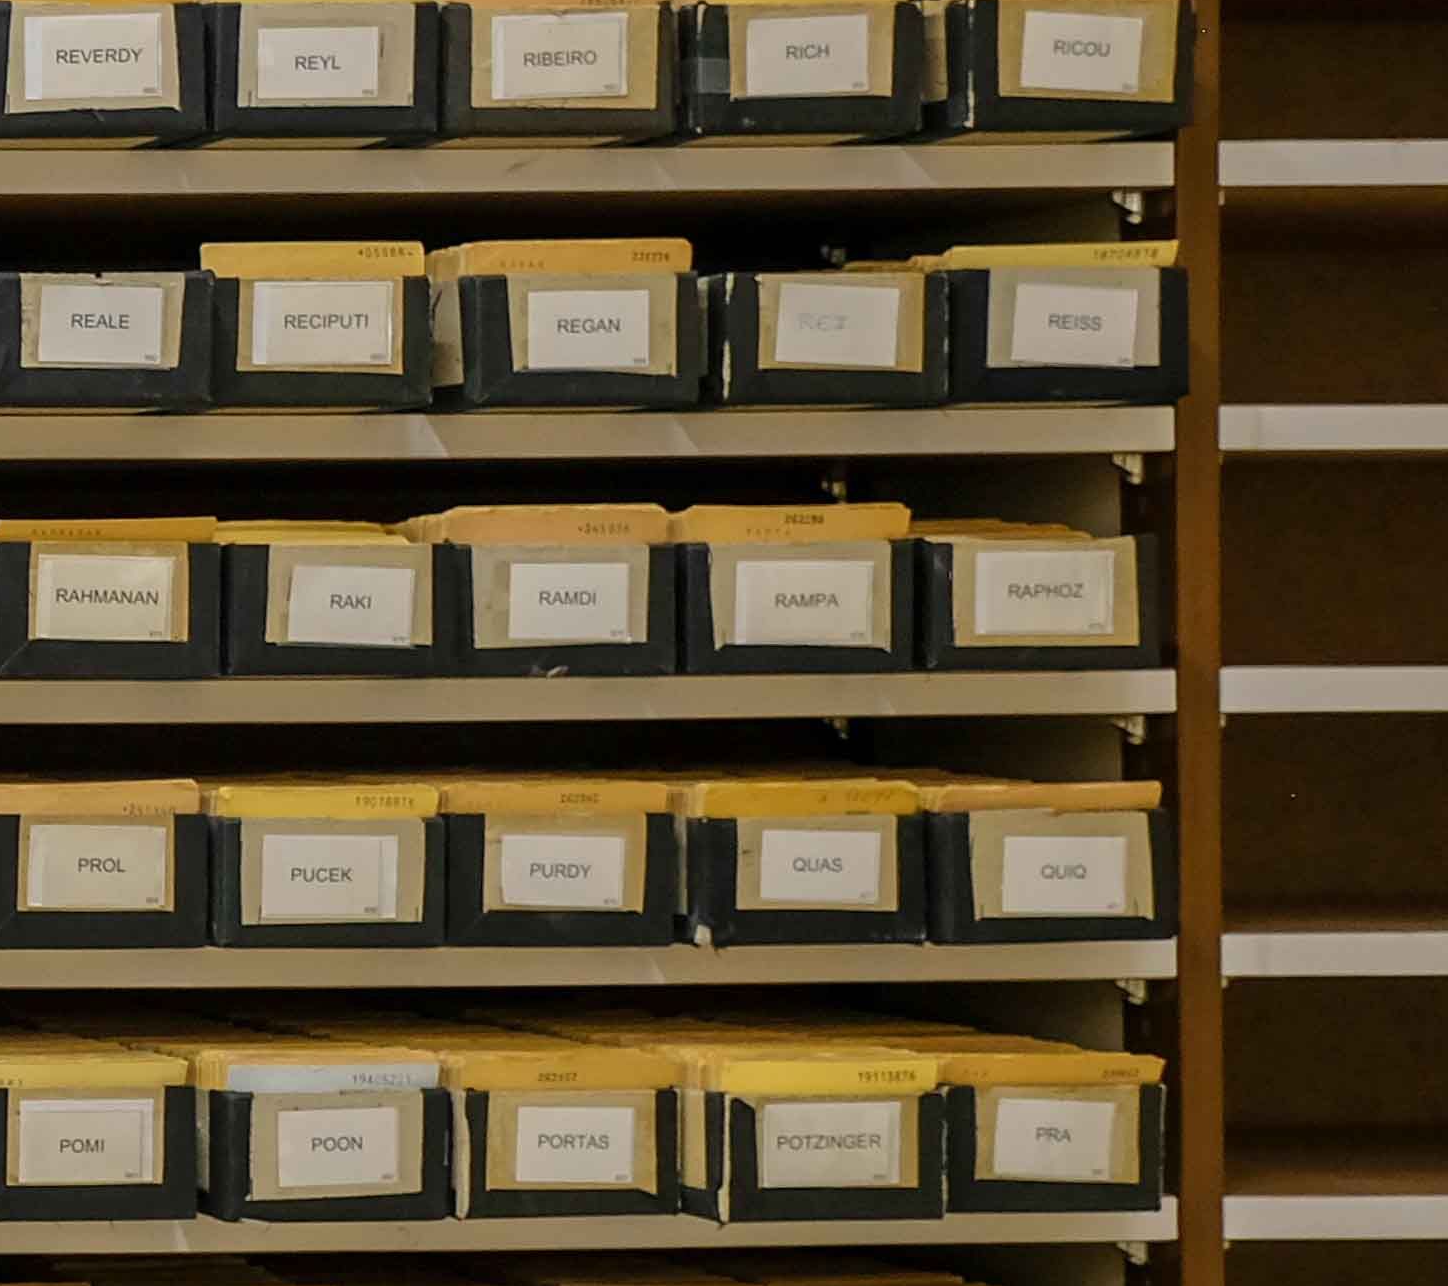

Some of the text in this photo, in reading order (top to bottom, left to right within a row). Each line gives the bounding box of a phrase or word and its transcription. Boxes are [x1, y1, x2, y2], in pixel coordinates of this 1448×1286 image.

[294, 54, 341, 71] REYL
[522, 49, 598, 68] RIBEIRO
[283, 312, 369, 330] RECIPUTI
[556, 317, 621, 334] REGAN
[329, 593, 372, 610] RAKI
[538, 590, 597, 606] RAMDI
[290, 867, 353, 884] PUCEK
[529, 862, 592, 880] PURDY
[311, 1136, 363, 1153] POON
[537, 1133, 610, 1151] PORTAS
